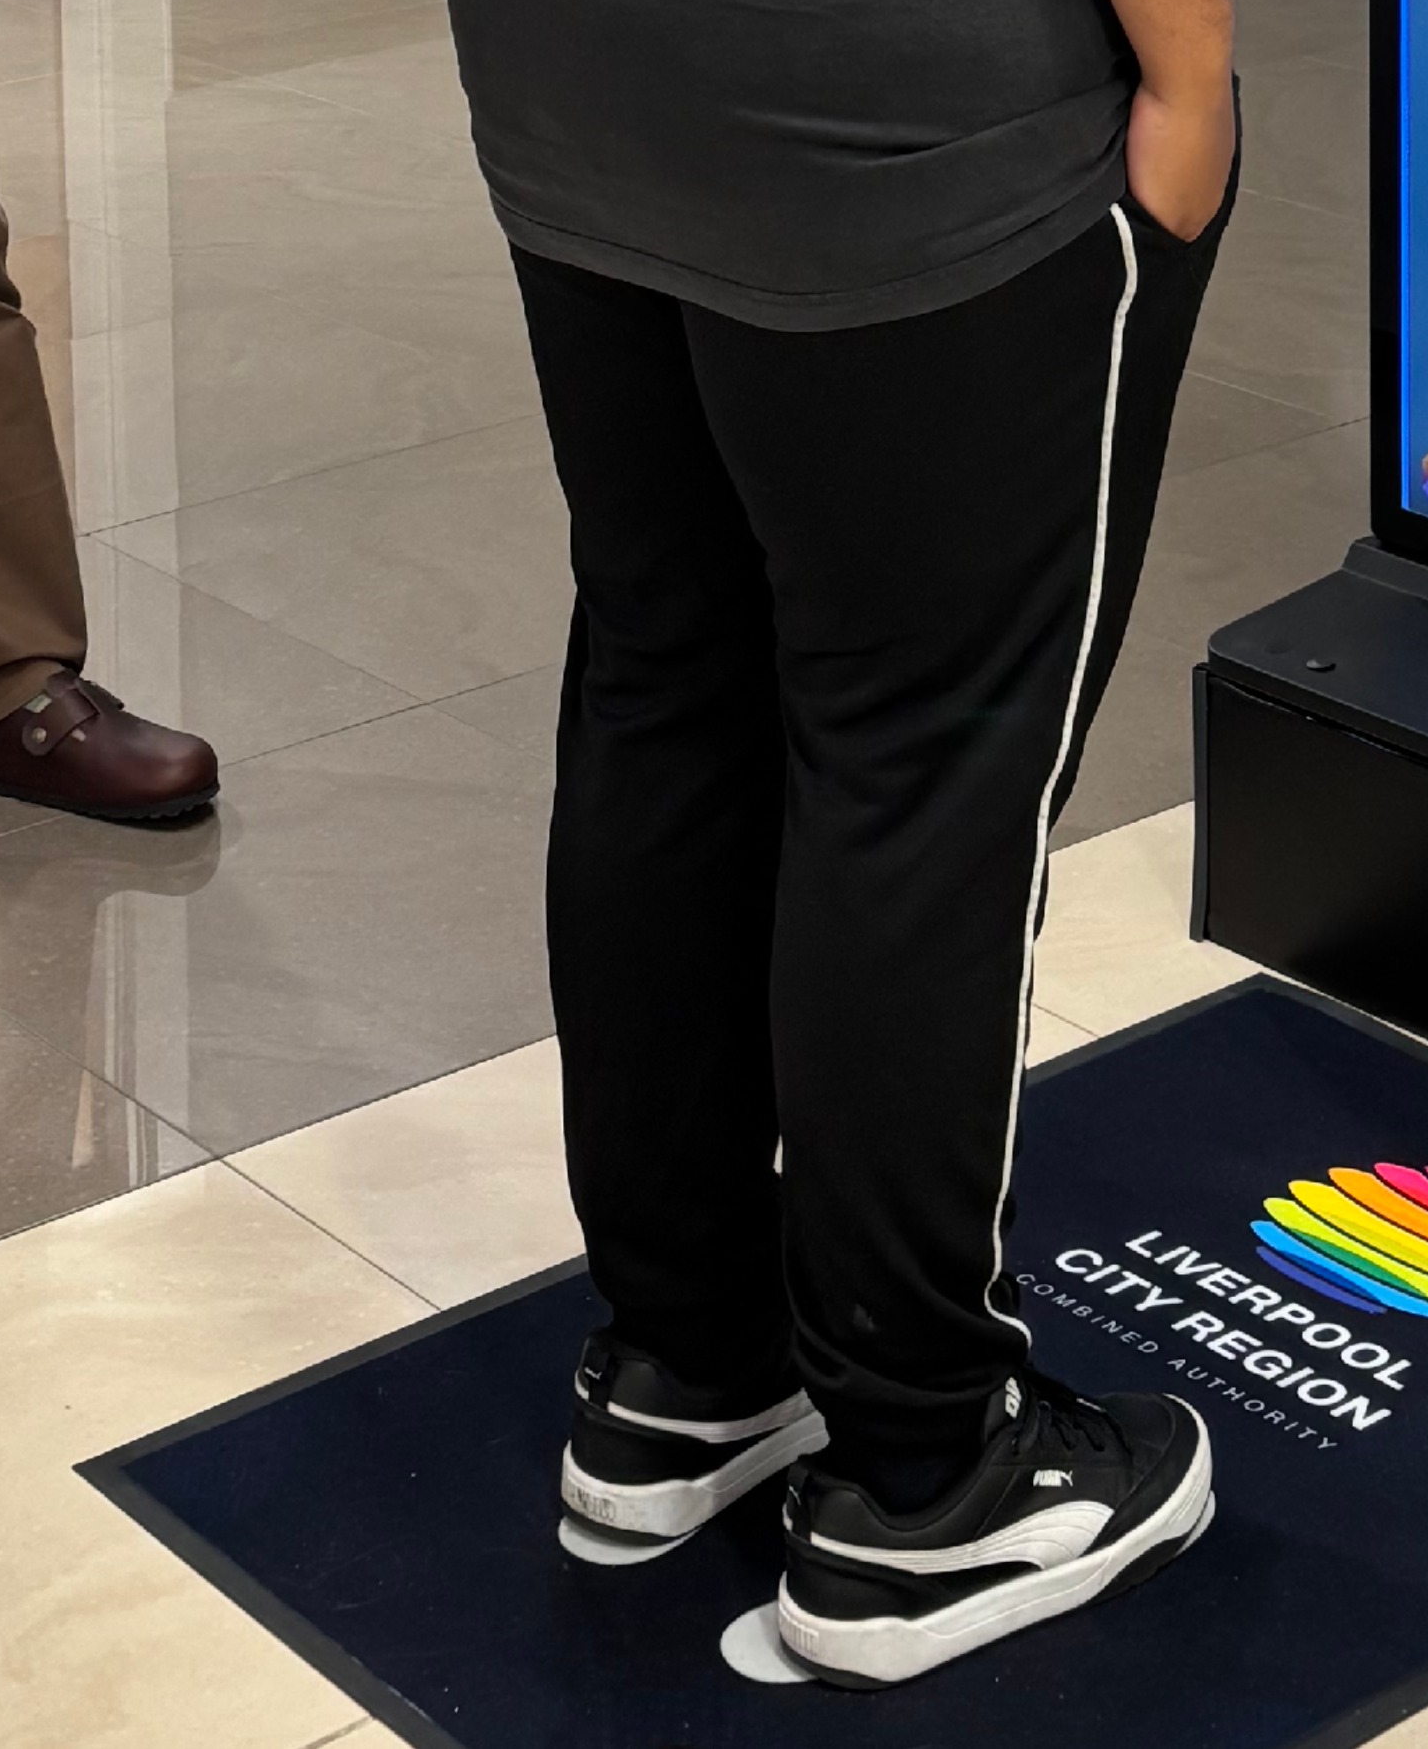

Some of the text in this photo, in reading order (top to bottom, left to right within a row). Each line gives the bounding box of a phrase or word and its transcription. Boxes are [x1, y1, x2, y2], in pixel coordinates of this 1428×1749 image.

[1016, 1273, 1338, 1450] COMBINED AUTHORITY
[1055, 1248, 1392, 1431] CITY REGION
[1126, 1230, 1419, 1390] LIVERPOOL
